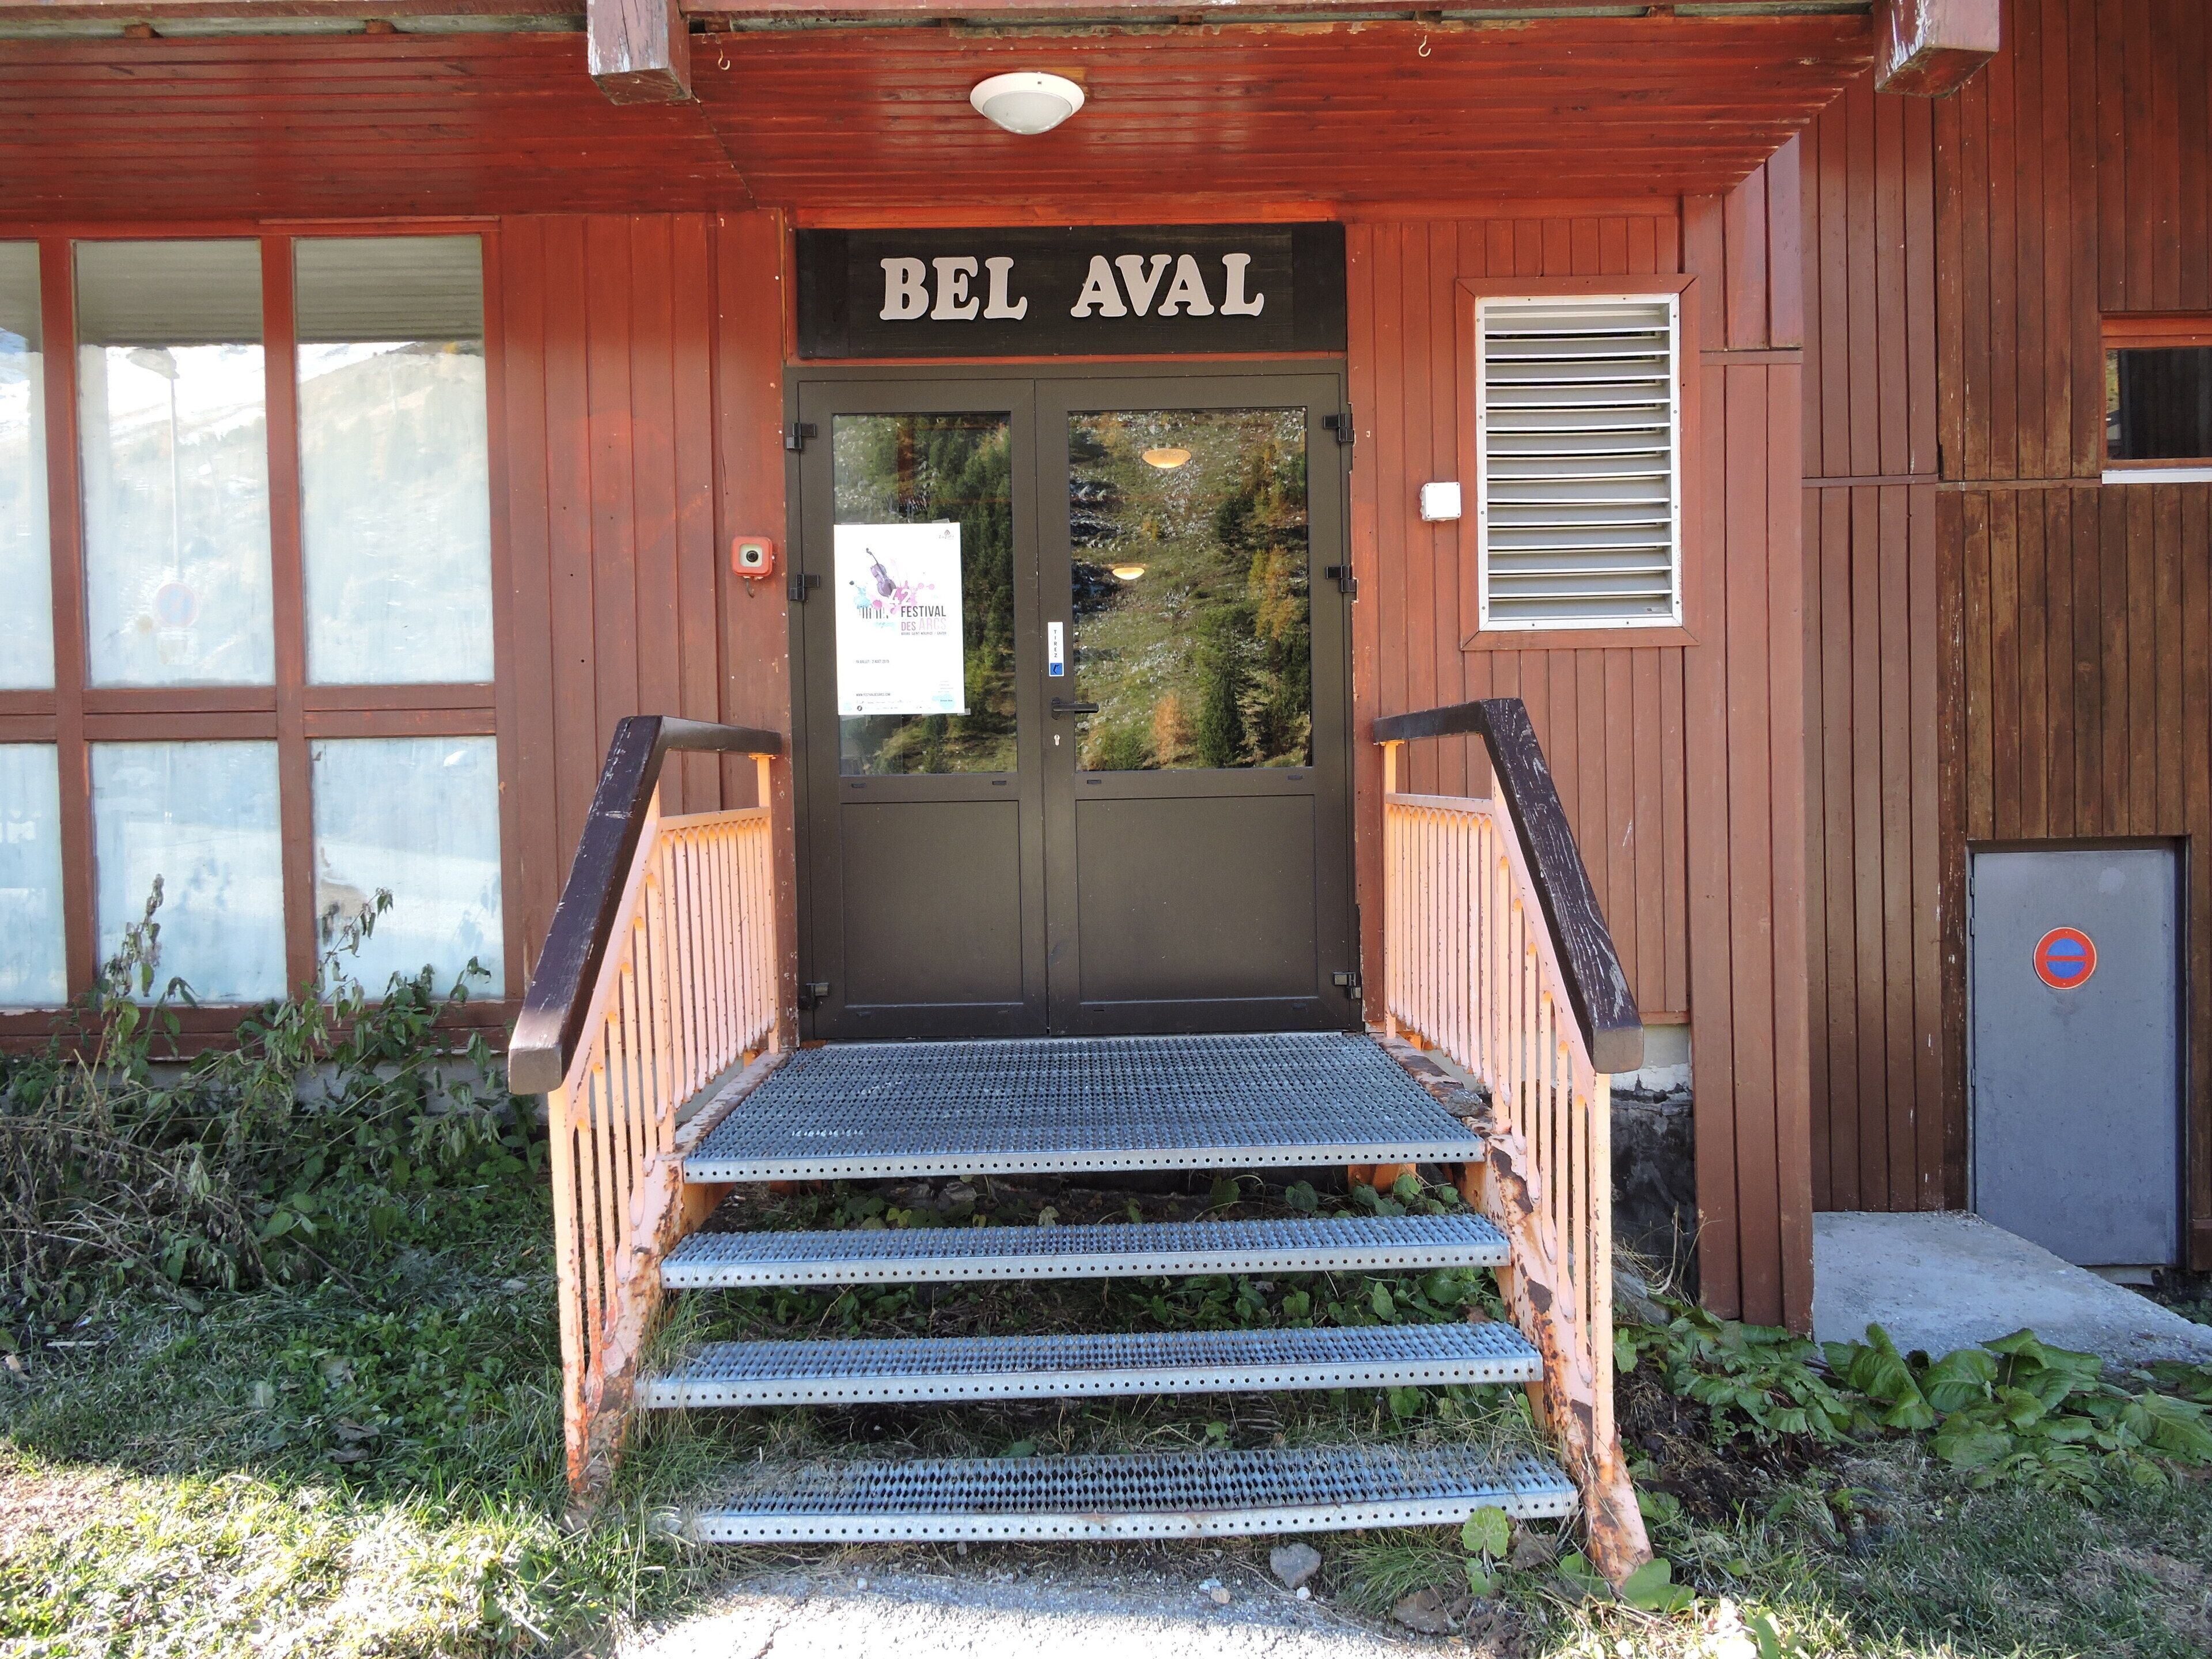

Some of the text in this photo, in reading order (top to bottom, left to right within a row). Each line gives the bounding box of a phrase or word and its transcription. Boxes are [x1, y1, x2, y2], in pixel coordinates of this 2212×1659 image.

[880, 253, 1265, 320] BEL AVAL
[889, 588, 911, 605] 42
[901, 605, 946, 618] FESTIVAL
[901, 622, 916, 631] DES
[919, 618, 946, 630] ARCS
